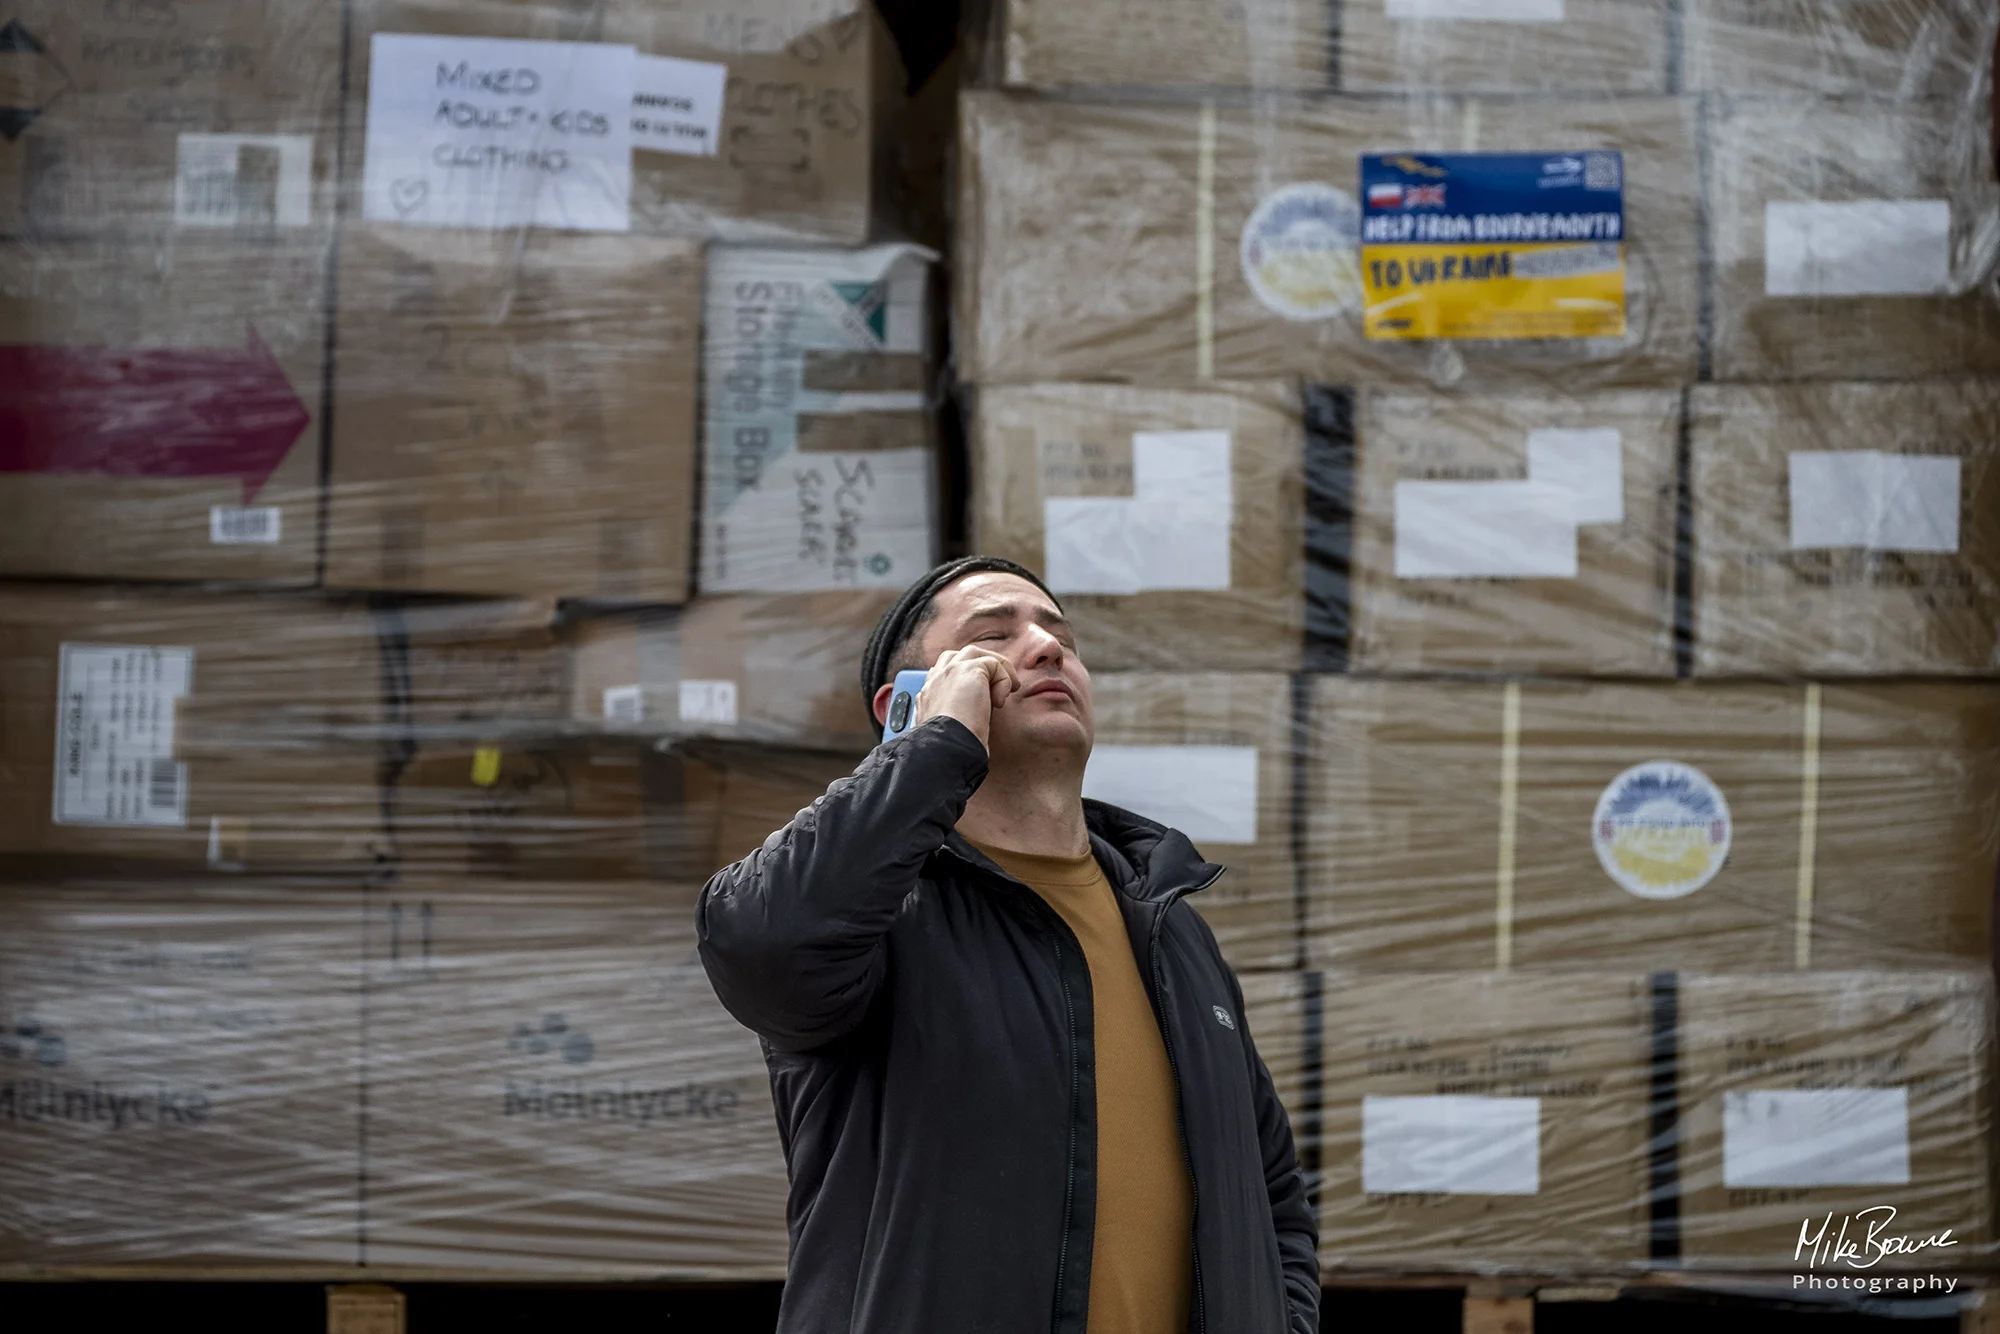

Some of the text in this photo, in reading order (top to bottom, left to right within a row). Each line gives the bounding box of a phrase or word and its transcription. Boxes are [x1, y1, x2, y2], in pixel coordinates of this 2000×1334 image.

[435, 61, 542, 96] MIXED
[431, 142, 572, 174] CLOTHING
[1365, 213, 1415, 240] HELP
[1416, 213, 1472, 240] FROM
[1473, 212, 1620, 240] BOURNEMOUTH
[1369, 259, 1401, 289] TO
[1407, 251, 1513, 286] UKRAINE
